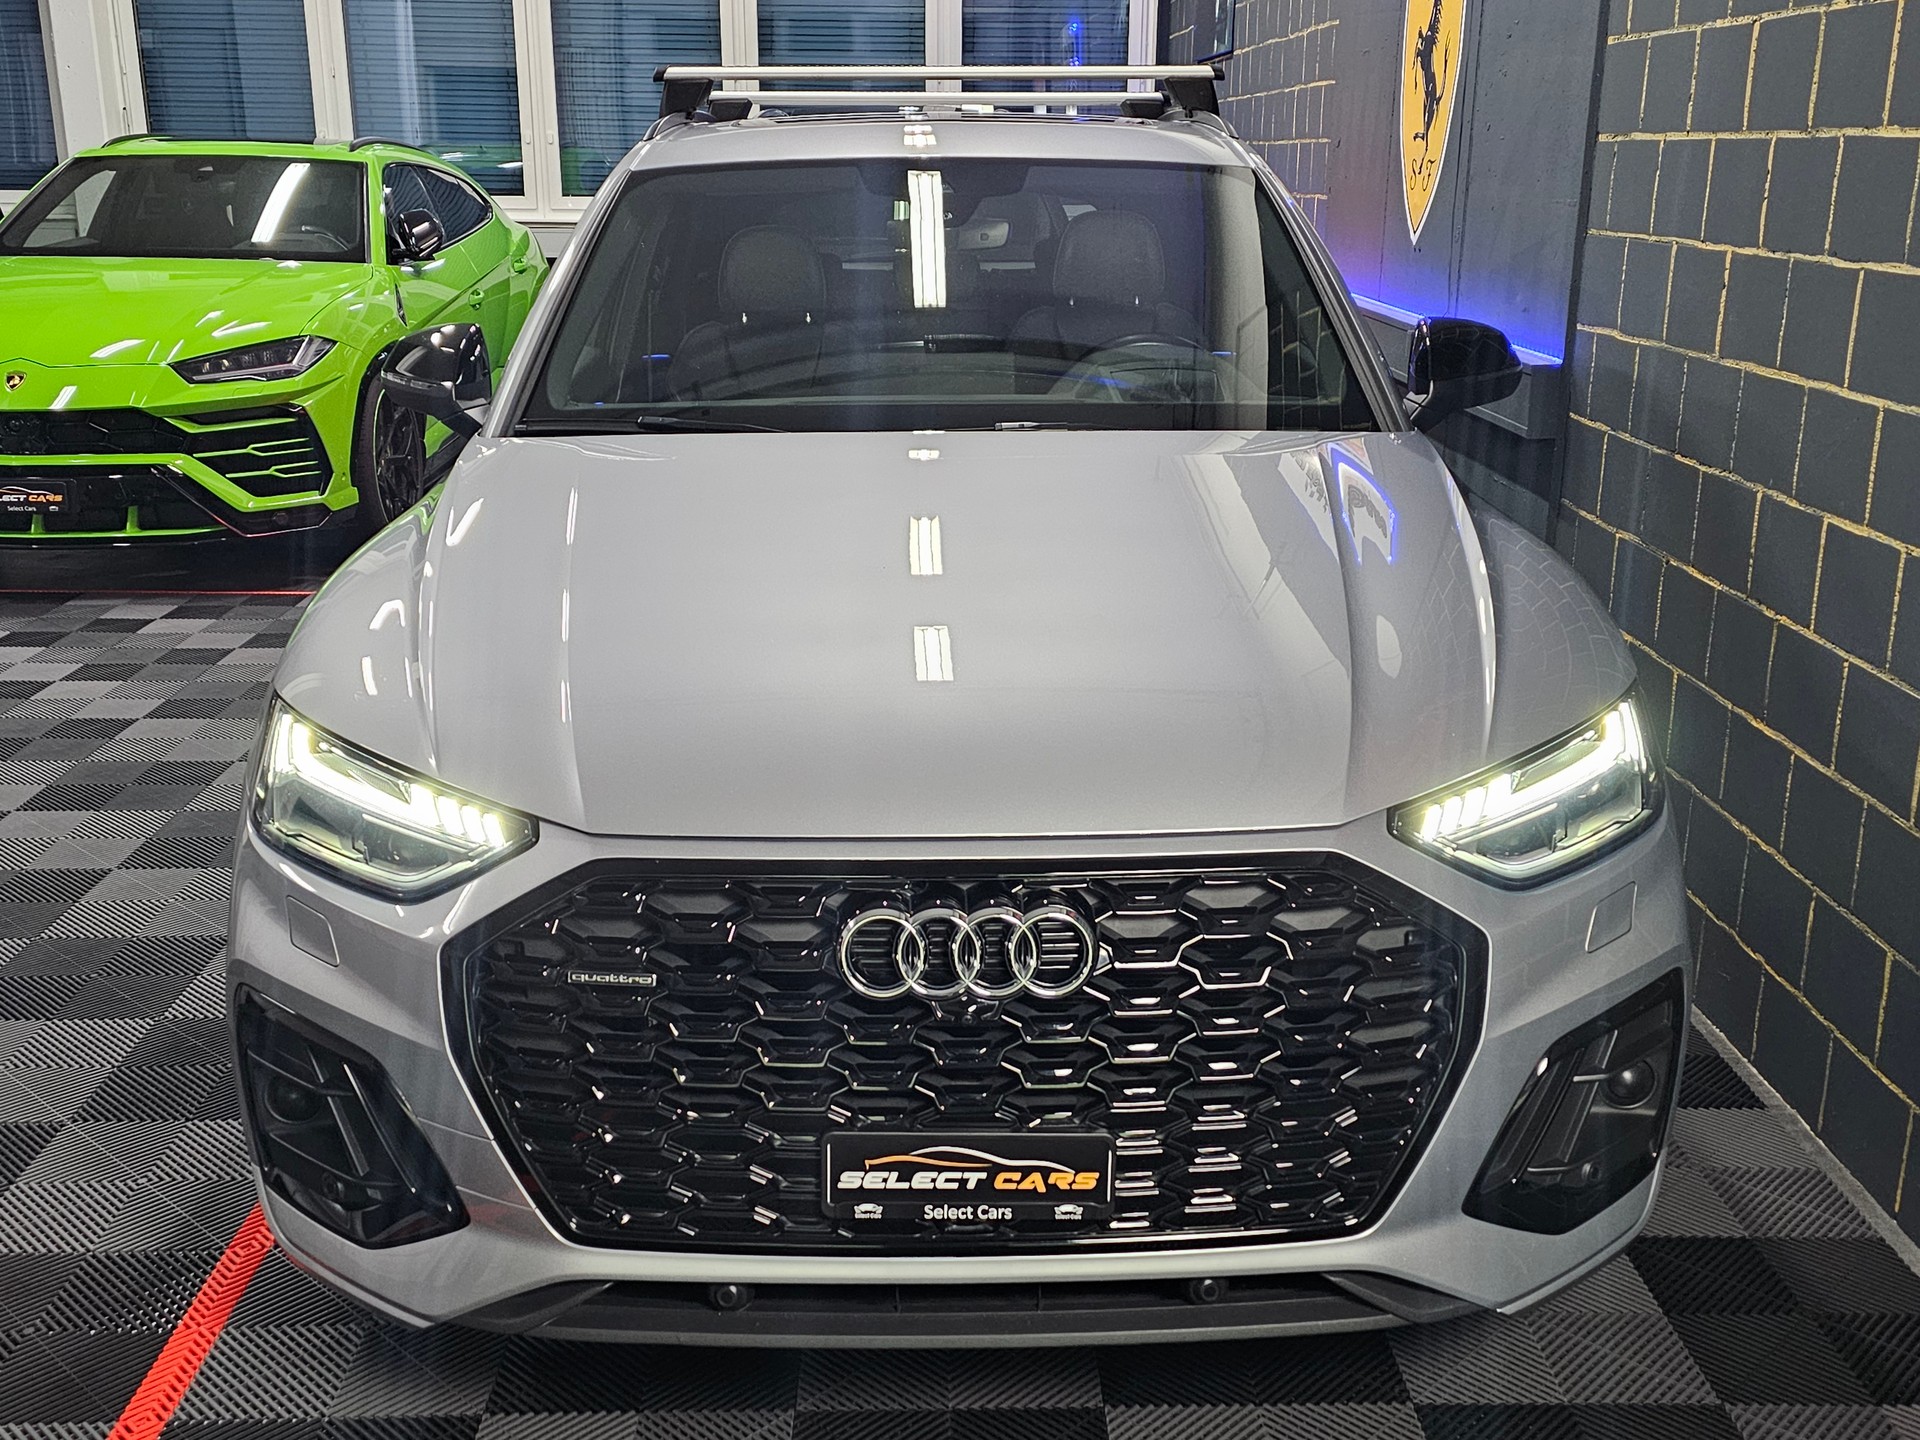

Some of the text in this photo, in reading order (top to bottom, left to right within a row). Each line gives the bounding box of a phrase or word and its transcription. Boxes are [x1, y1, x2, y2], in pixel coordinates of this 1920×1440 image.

[28, 494, 63, 503] CARS
[571, 973, 653, 984] quattro
[837, 1171, 1100, 1193] SELECT CARS
[923, 1203, 1013, 1220] Select Cars
